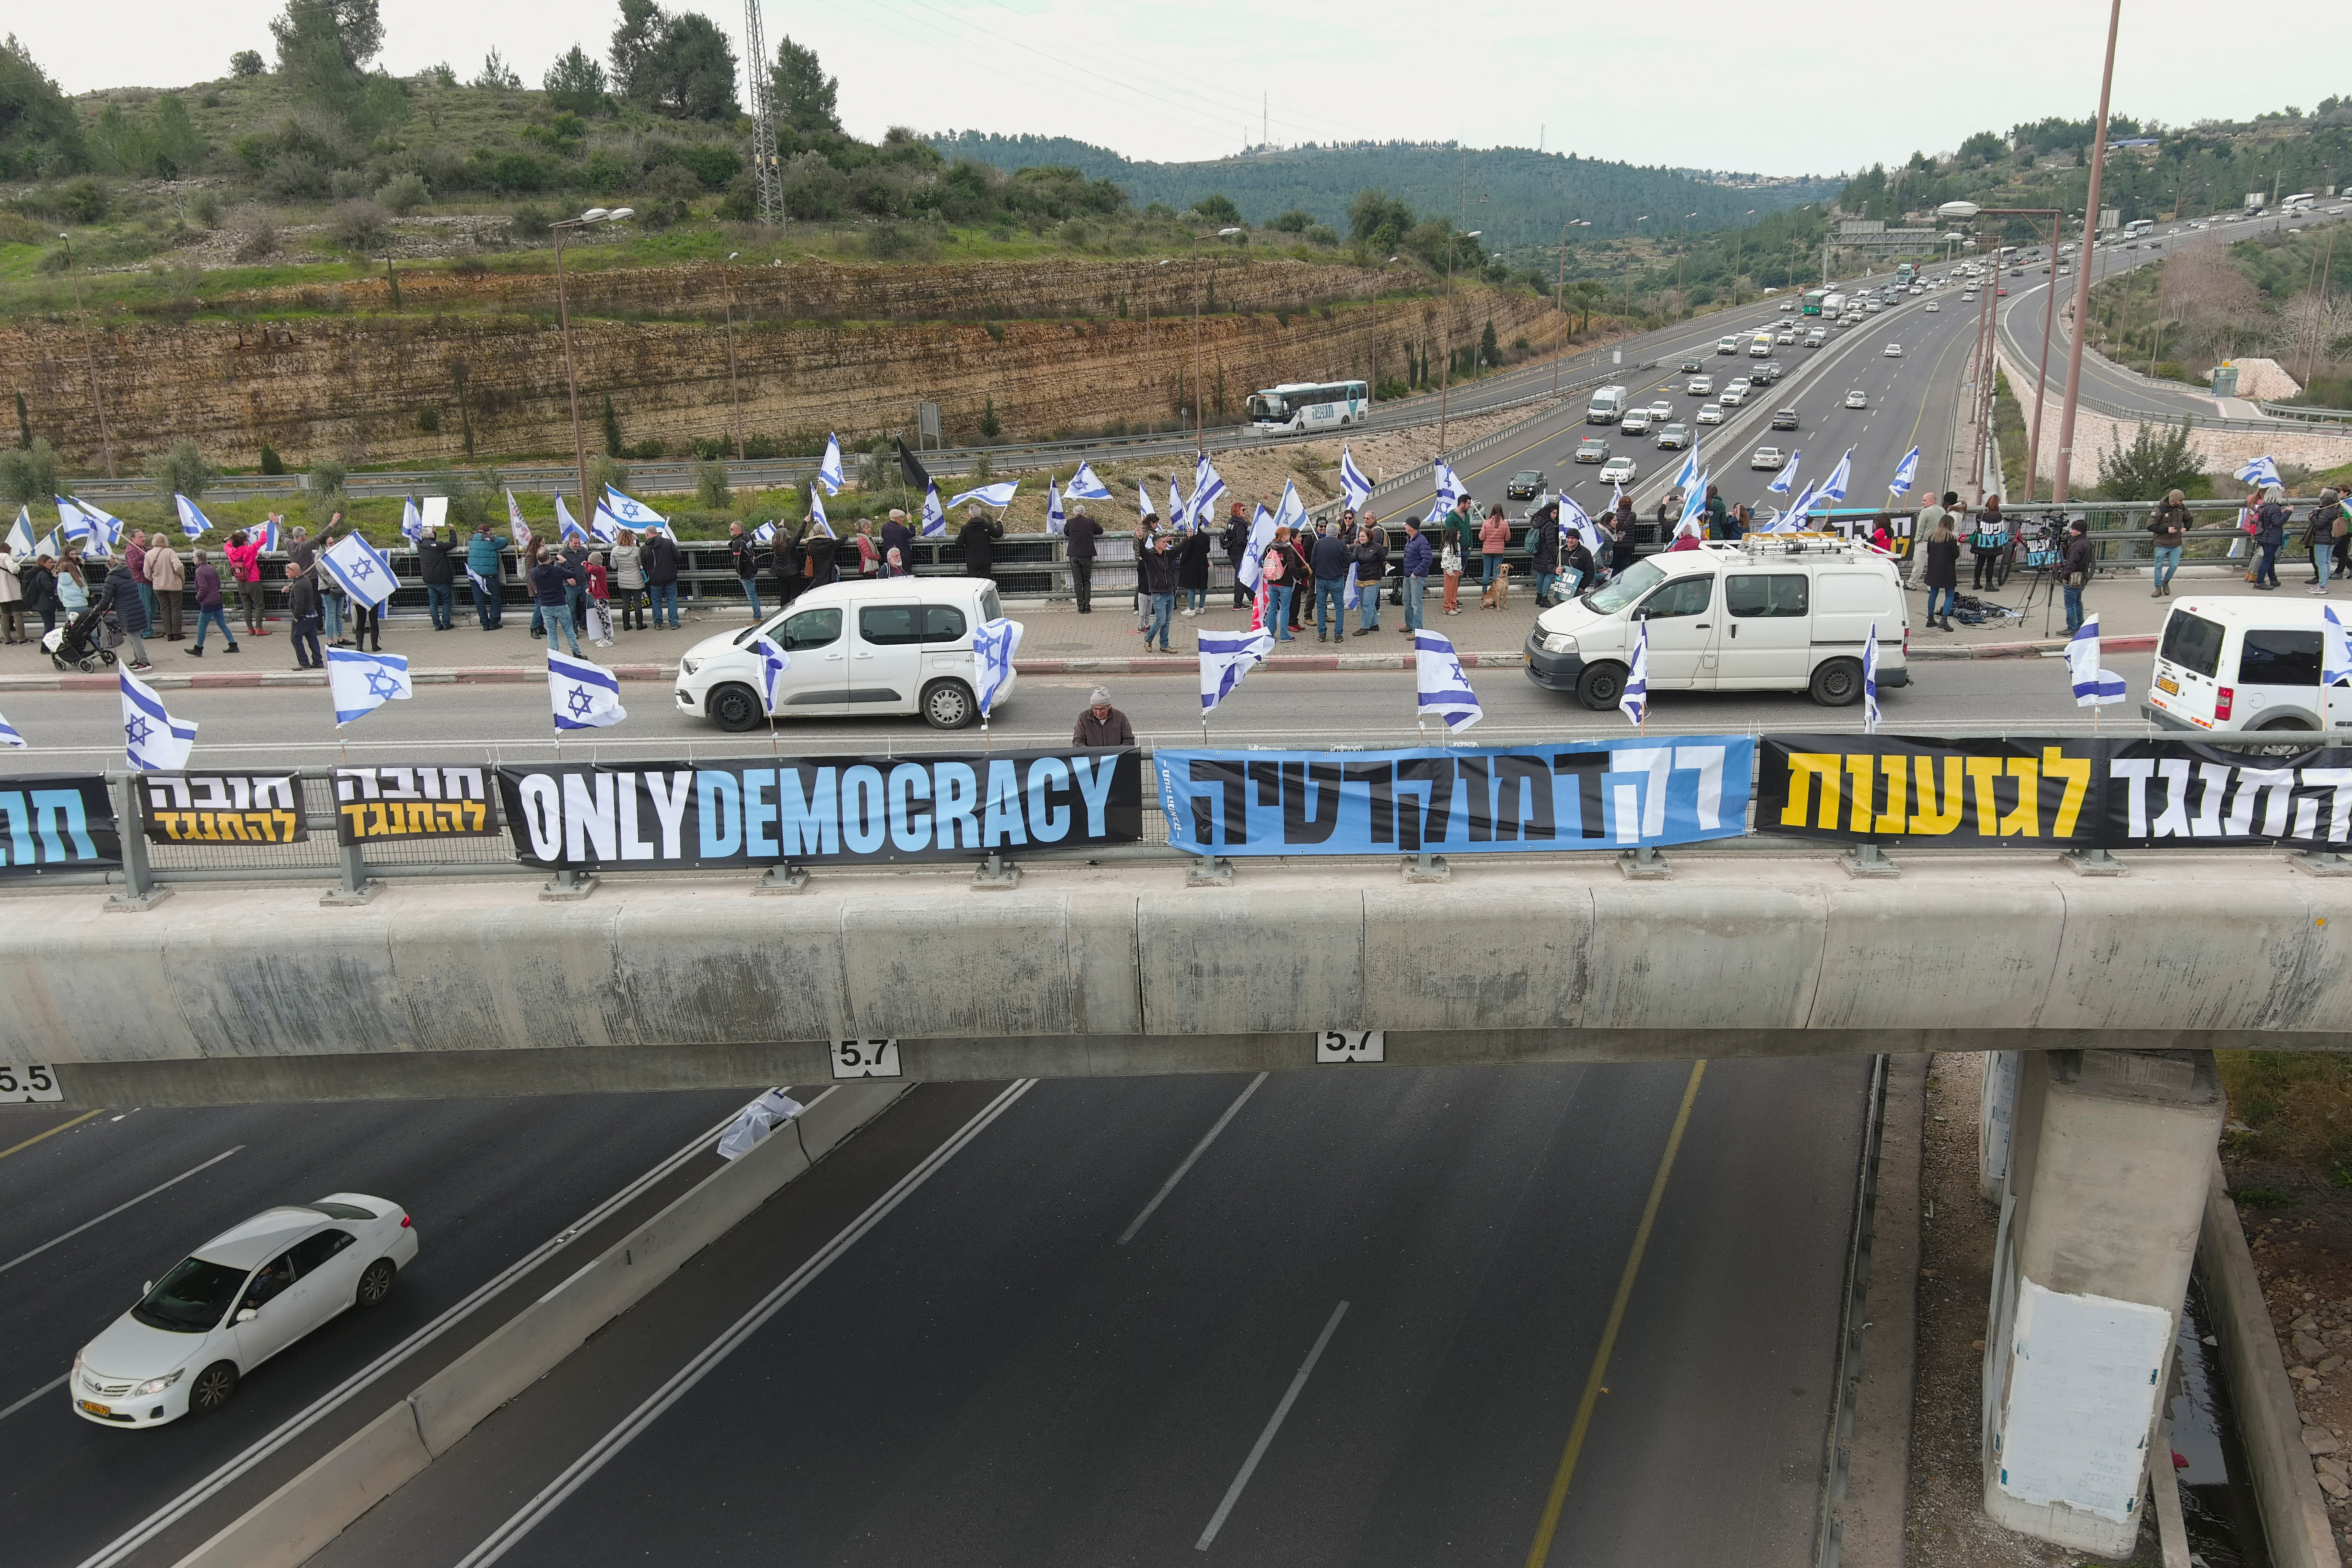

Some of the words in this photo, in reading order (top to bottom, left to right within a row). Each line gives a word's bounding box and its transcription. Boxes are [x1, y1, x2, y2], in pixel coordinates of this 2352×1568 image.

[1312, 404, 1334, 420] תנופה
[147, 777, 294, 808] חובה
[337, 768, 484, 800] חובה
[1189, 751, 1611, 851] דמוקרטיה
[1612, 745, 1725, 844] רק
[1781, 747, 2091, 837] לגזענות
[340, 800, 486, 837] להתנגד
[519, 771, 692, 861] ONLY
[696, 755, 1118, 858] DEMOCRACY
[1167, 796, 1182, 831] המאבק
[154, 809, 296, 842] להתנגד
[841, 1039, 888, 1066] 5.7
[0, 1066, 52, 1092] 5.5
